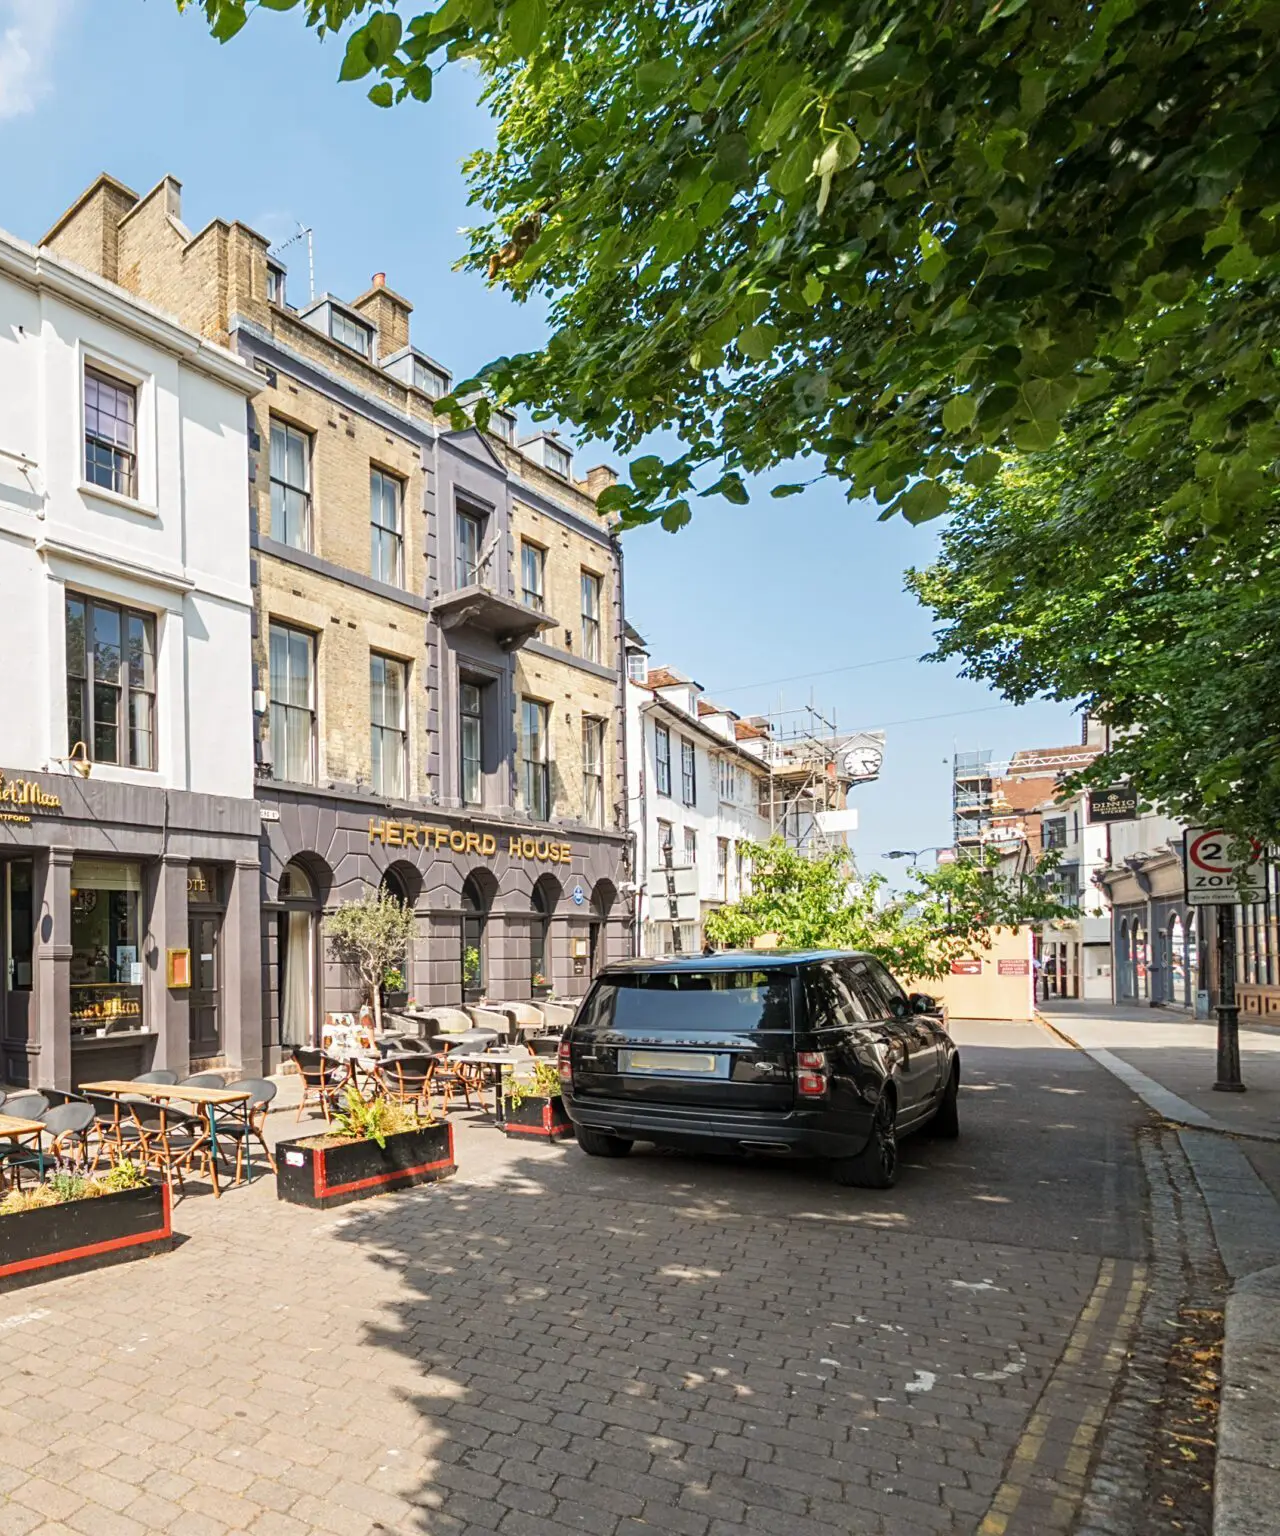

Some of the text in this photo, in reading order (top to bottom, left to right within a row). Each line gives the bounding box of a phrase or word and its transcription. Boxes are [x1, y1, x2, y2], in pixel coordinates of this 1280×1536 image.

[15, 779, 61, 807] Man
[368, 818, 573, 863] HERTFORD HOUSE
[186, 878, 214, 893] OTEL
